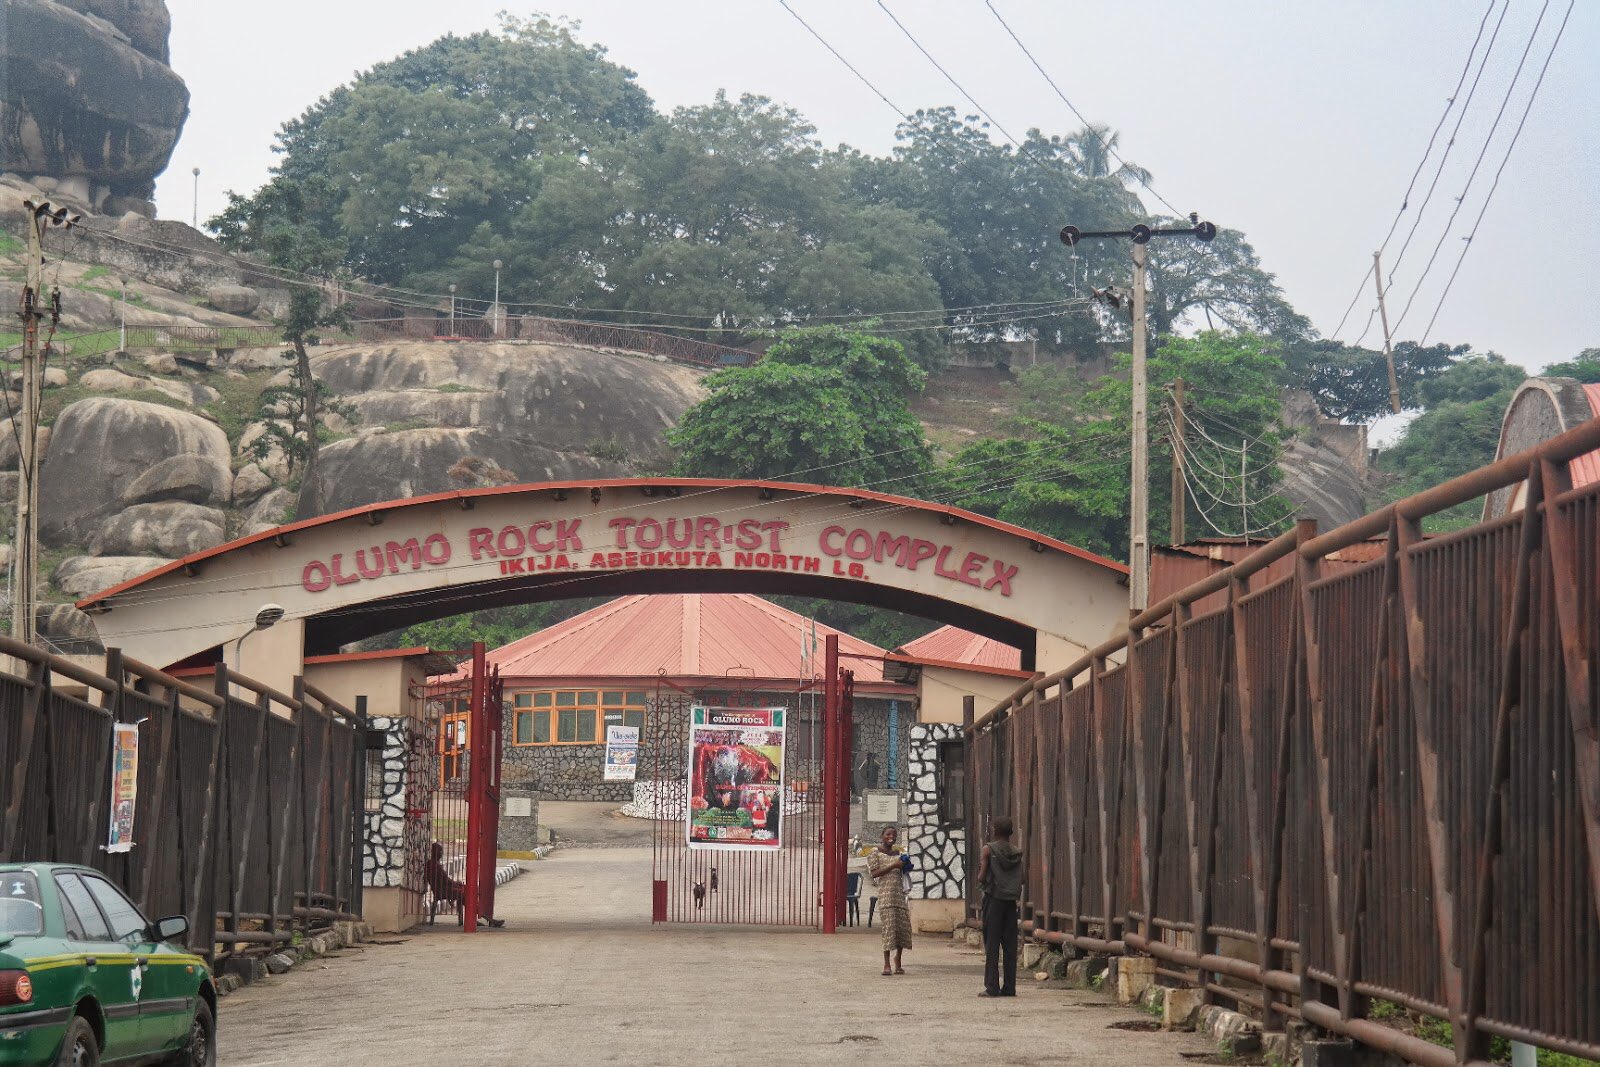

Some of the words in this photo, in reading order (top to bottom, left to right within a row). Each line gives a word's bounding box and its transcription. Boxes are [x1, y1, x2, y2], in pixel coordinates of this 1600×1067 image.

[303, 533, 451, 592] OLUMO
[469, 519, 583, 560] ROCK
[608, 517, 790, 552] TOURIST
[819, 525, 1019, 597] COMPLEX
[589, 551, 722, 568] ABEOKUTA
[734, 552, 820, 572] NORTH
